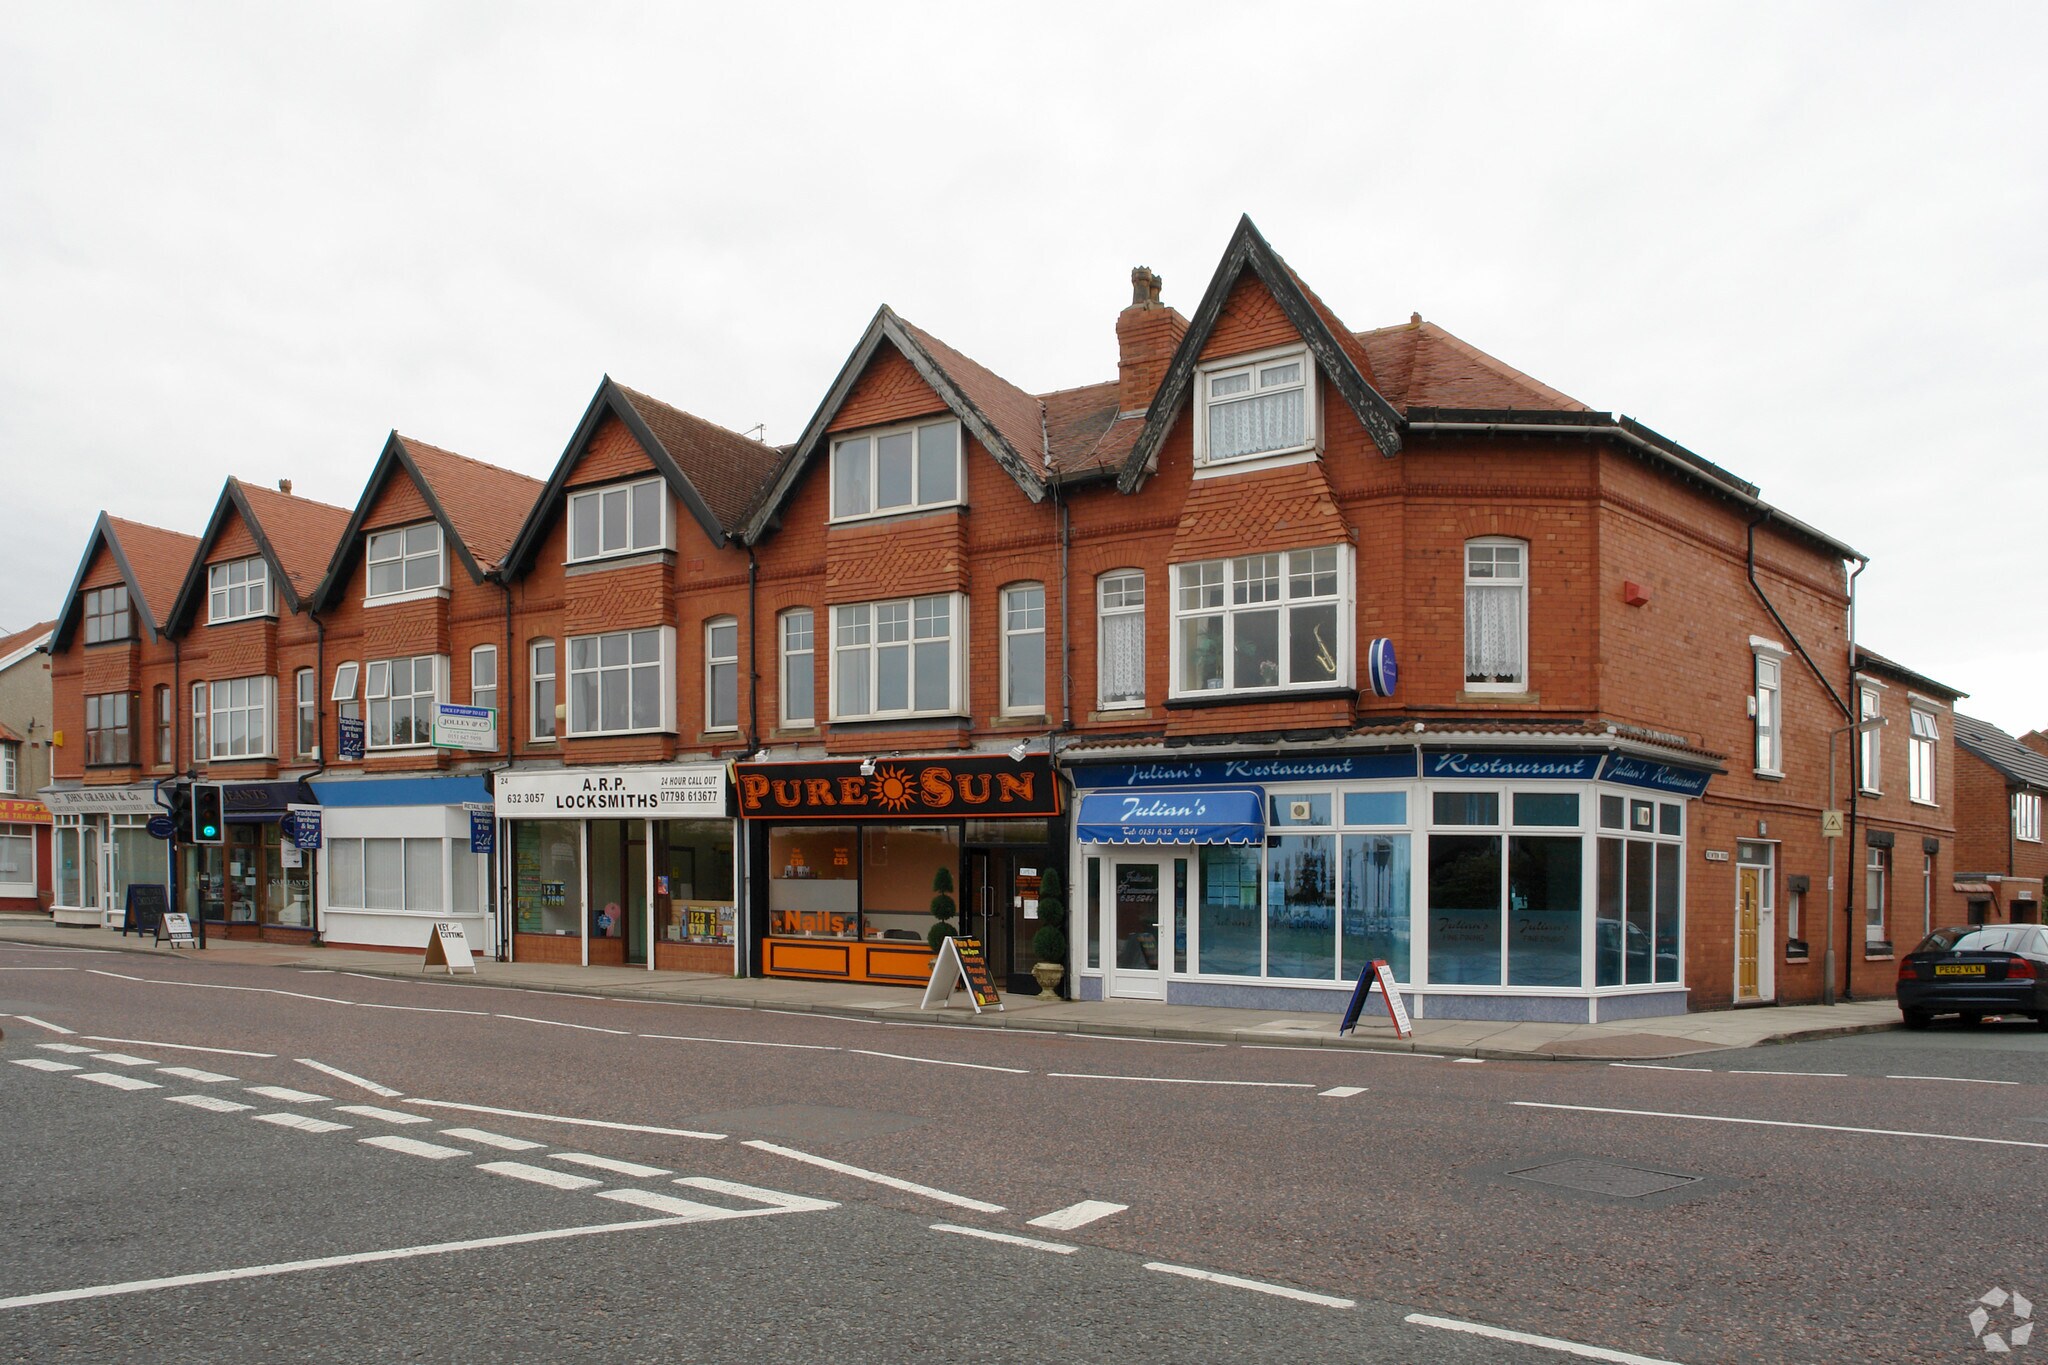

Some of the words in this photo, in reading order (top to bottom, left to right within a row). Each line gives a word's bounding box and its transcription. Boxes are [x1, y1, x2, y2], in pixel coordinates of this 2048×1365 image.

[1224, 758, 1353, 777] Restaurant
[1434, 753, 1587, 774] Restaurant
[1606, 756, 1646, 780] Julian's
[1652, 764, 1701, 789] Restaurant
[582, 778, 626, 791] A.R.P.
[661, 777, 668, 785] 24
[669, 777, 687, 785] HOUR
[688, 777, 703, 785] CALL
[704, 776, 717, 785] OUT
[740, 773, 869, 809] PURE
[920, 766, 1035, 808] SUN
[84, 792, 117, 802] GRAHAM
[118, 792, 126, 800] &
[507, 794, 521, 803] 632
[524, 793, 545, 803] 3057
[556, 794, 658, 808] LOCKSMITHS
[660, 791, 685, 801] 07798
[688, 791, 718, 801] 613677
[1120, 798, 1206, 822] Julian's
[299, 832, 318, 842] Let
[1138, 828, 1154, 836] 0151
[475, 834, 492, 845] Let
[438, 923, 449, 931] KEY
[784, 910, 844, 932] Nails
